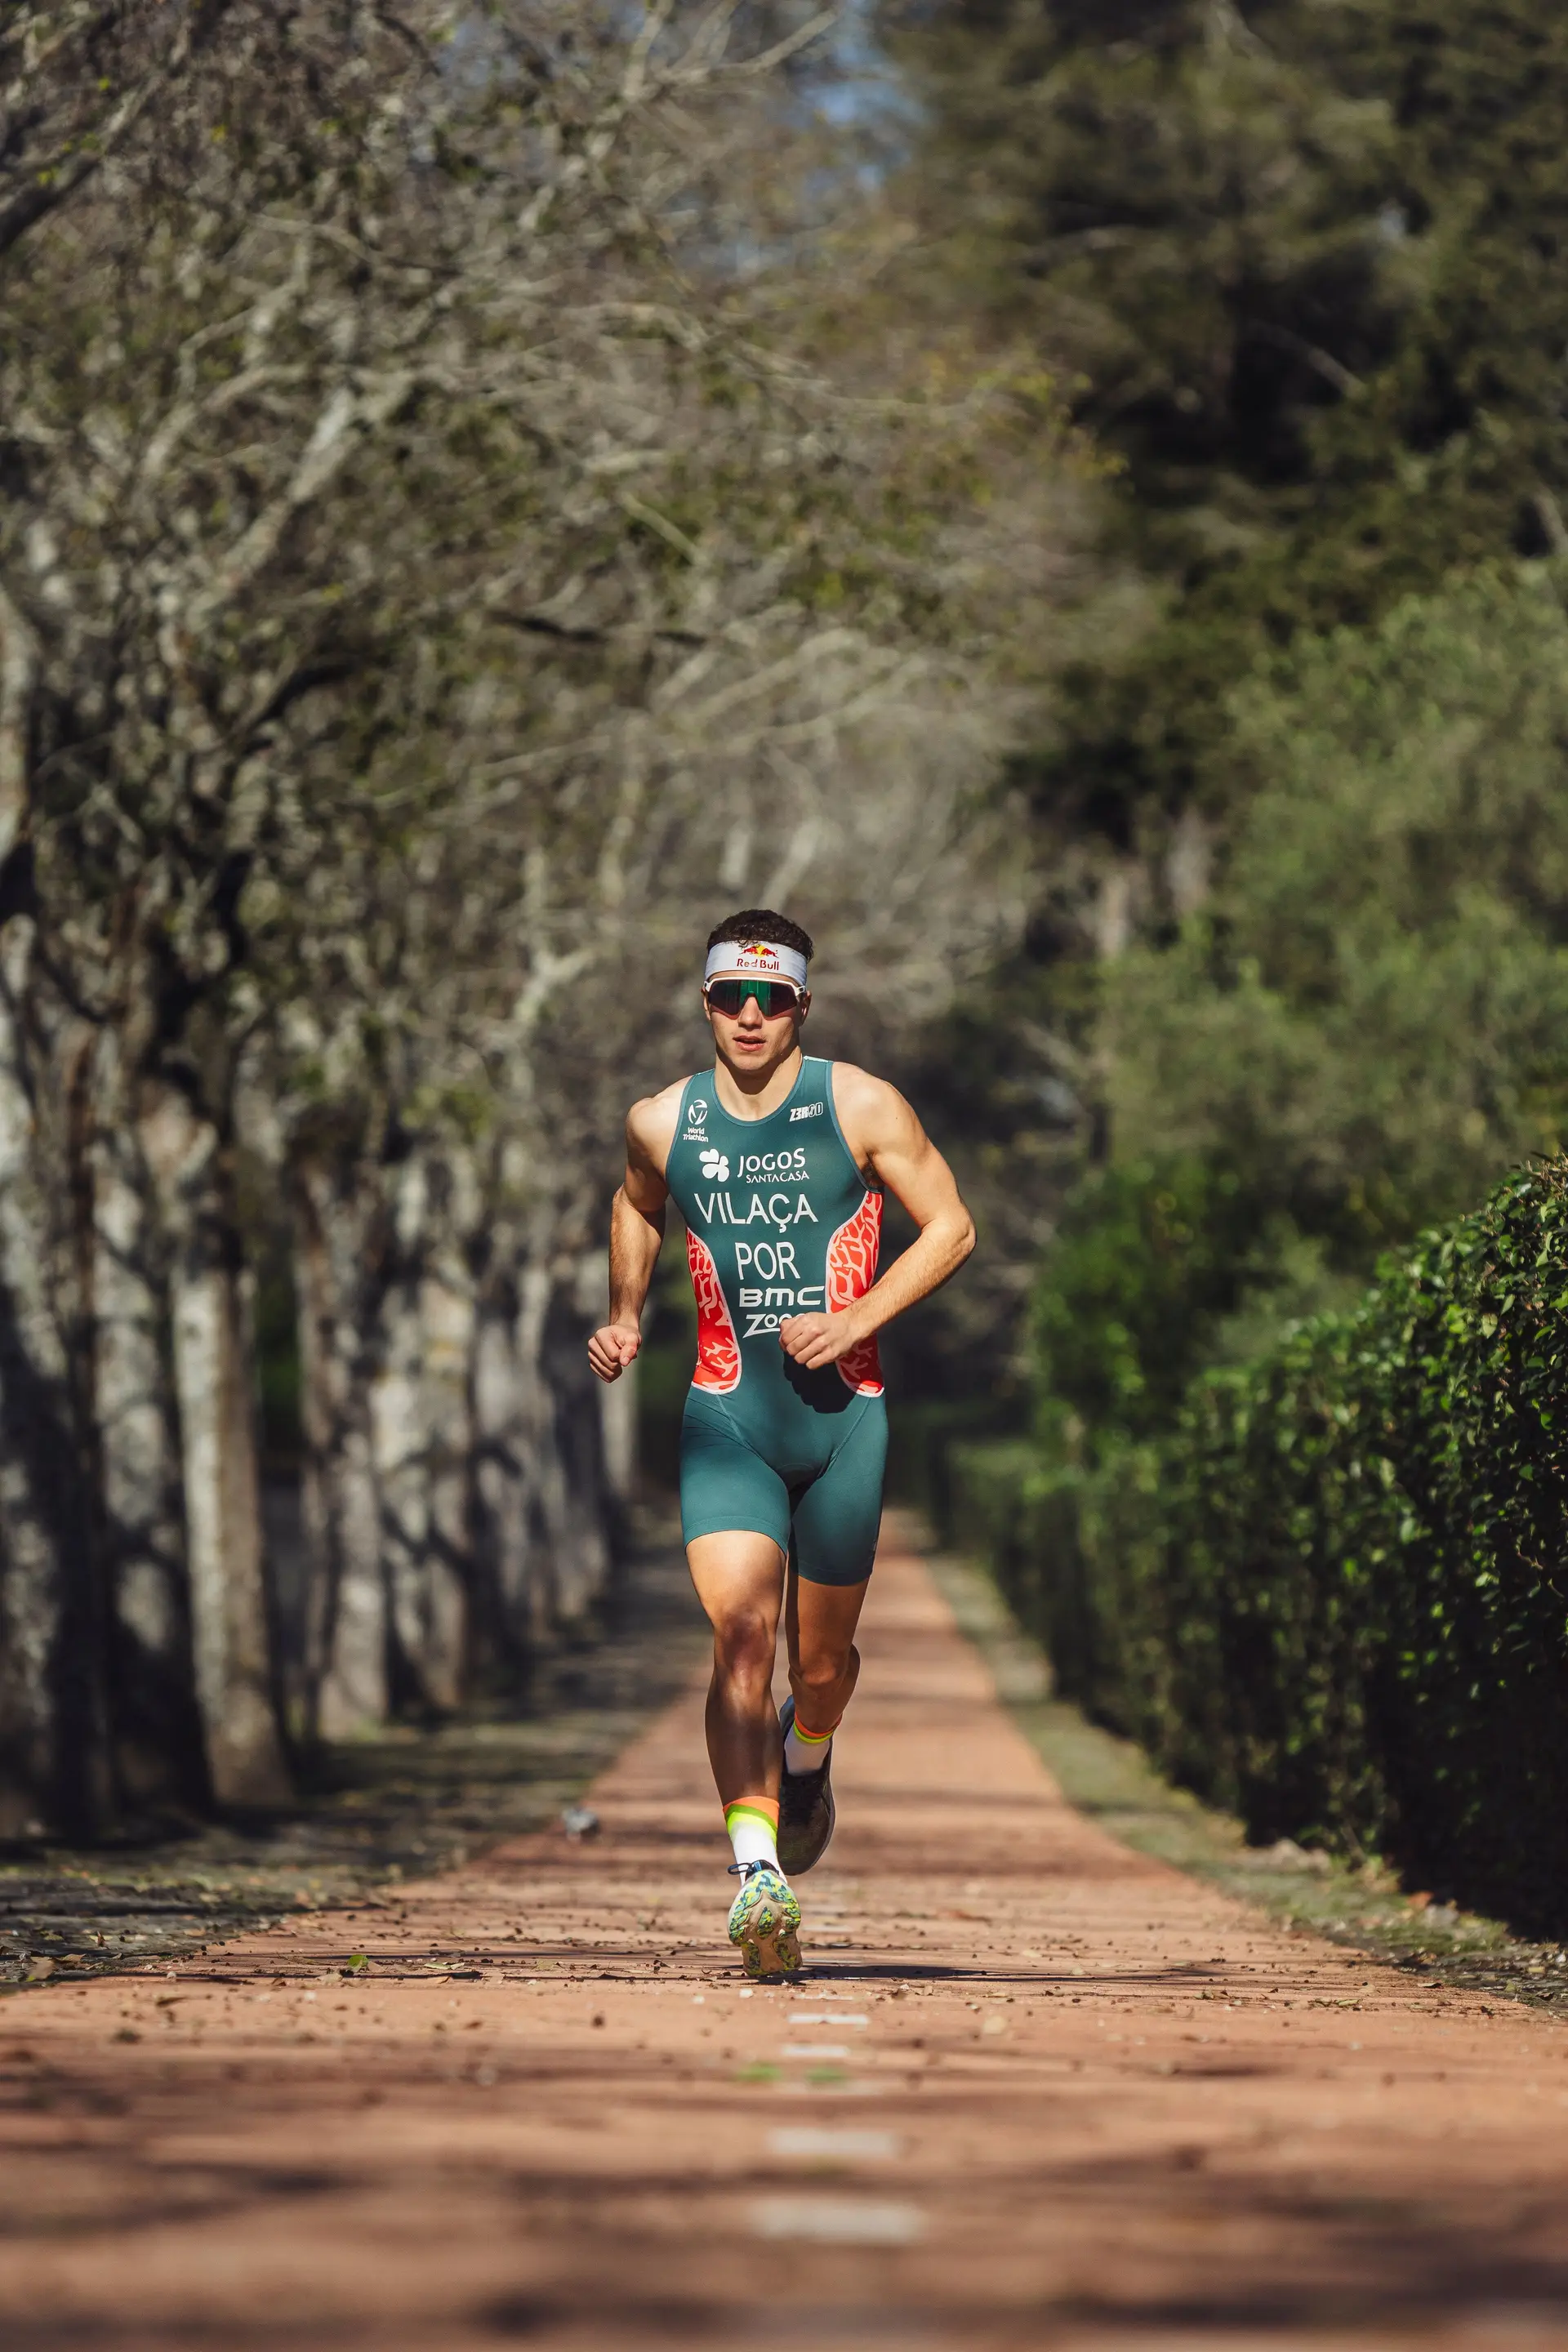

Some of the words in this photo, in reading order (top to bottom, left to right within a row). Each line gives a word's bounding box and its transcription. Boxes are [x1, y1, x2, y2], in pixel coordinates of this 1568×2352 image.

[737, 958, 758, 968] Red
[760, 960, 779, 971] Bull
[683, 1134, 708, 1143] Triathlon
[687, 1126, 704, 1134] World
[737, 1147, 806, 1178] JOGOS
[694, 1192, 818, 1233] VILAÇA
[735, 1241, 800, 1280] POR
[739, 1285, 825, 1307] BMC
